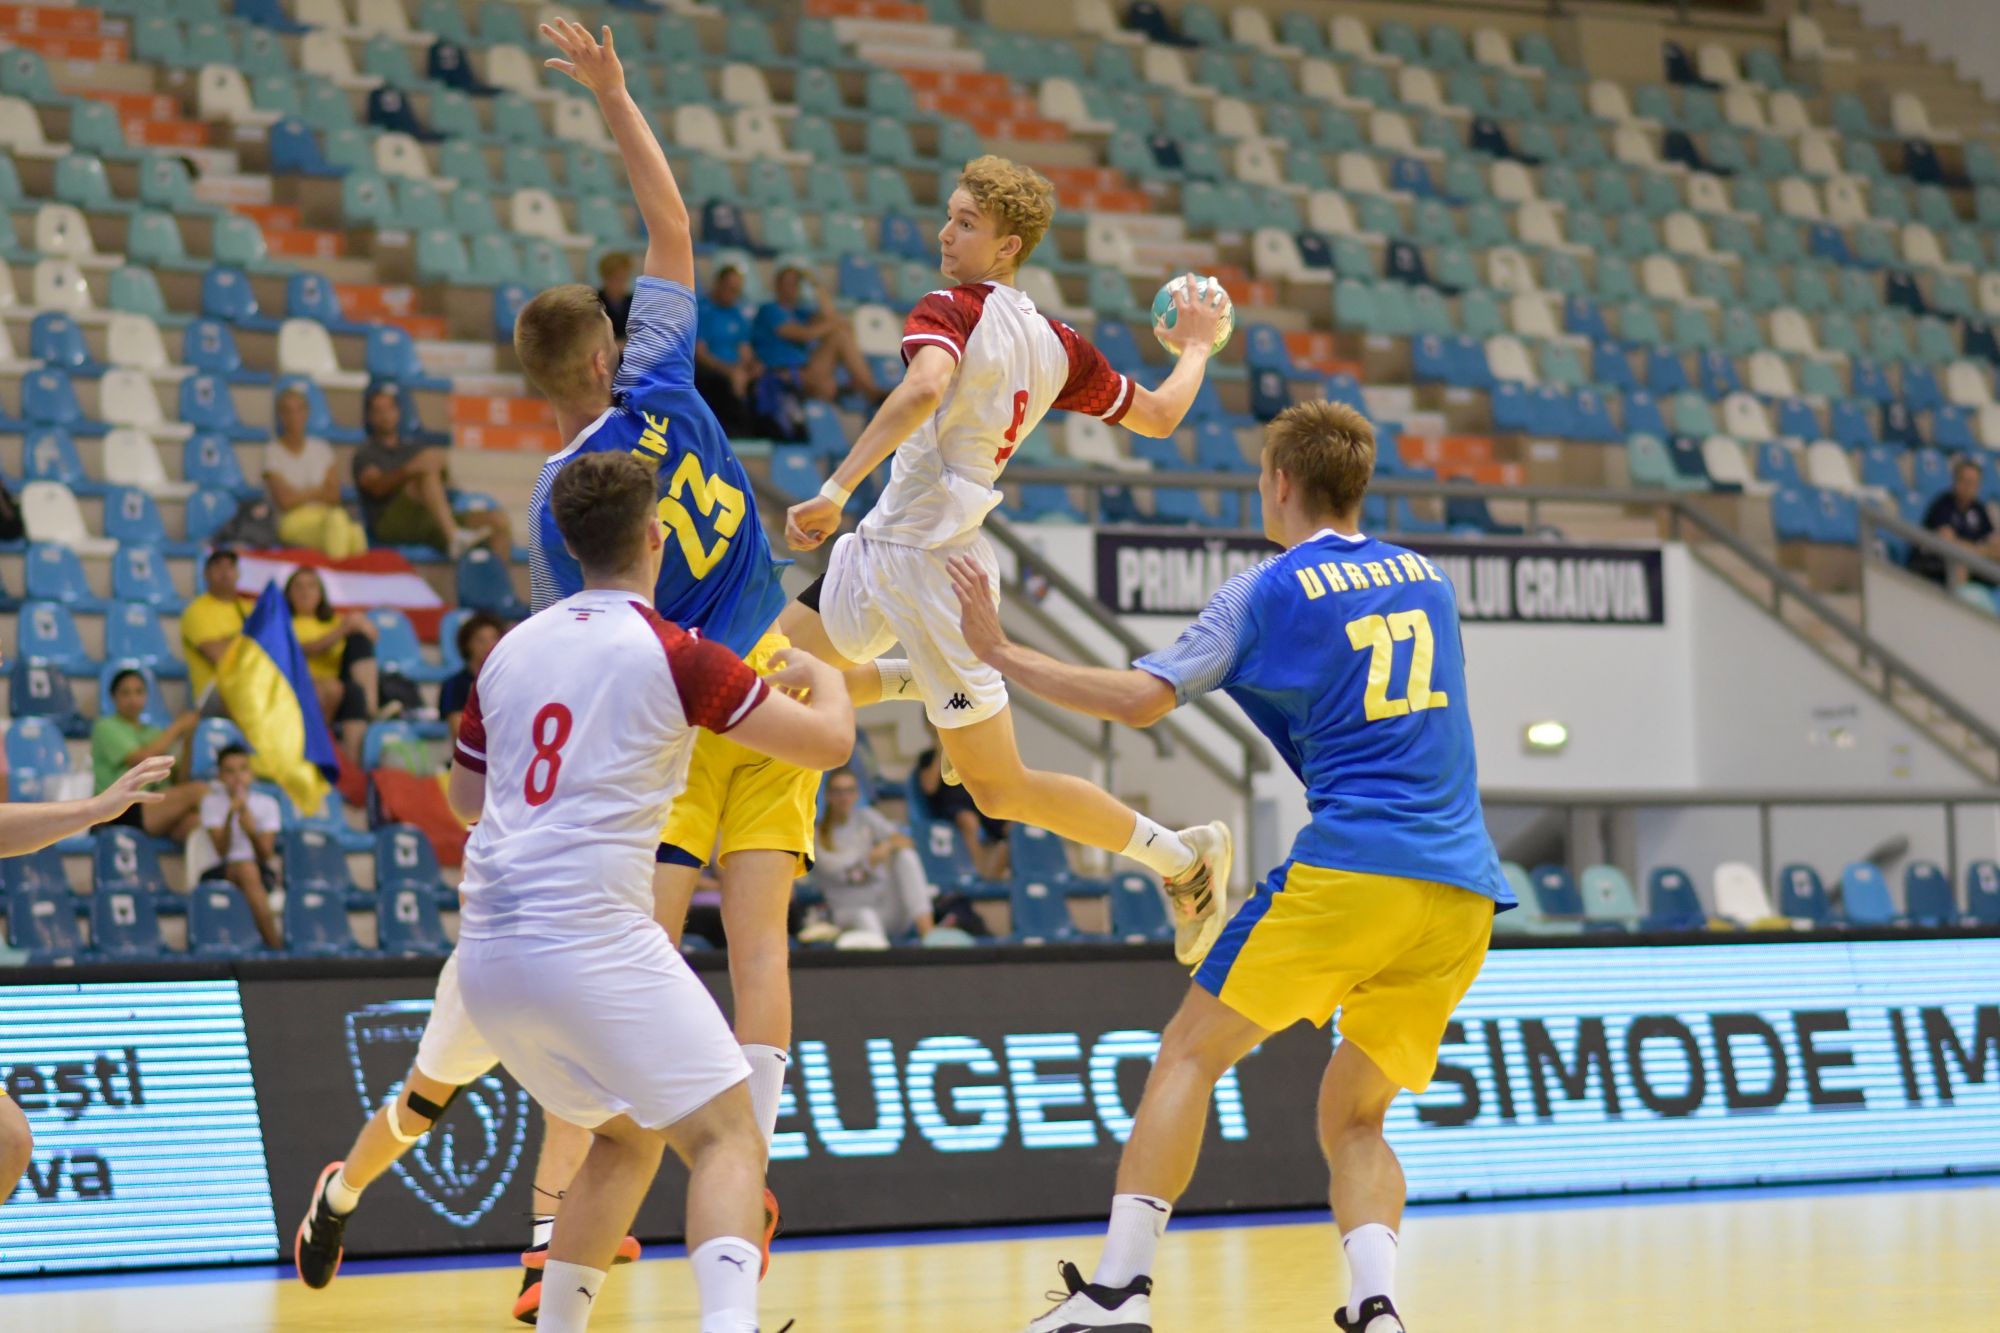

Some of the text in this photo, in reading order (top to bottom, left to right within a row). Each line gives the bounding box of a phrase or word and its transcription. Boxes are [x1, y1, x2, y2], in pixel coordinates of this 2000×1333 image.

[657, 452, 746, 580] 23
[1514, 557, 1651, 620] CRAIOVA
[1345, 609, 1448, 721] 22
[524, 702, 573, 807] 8
